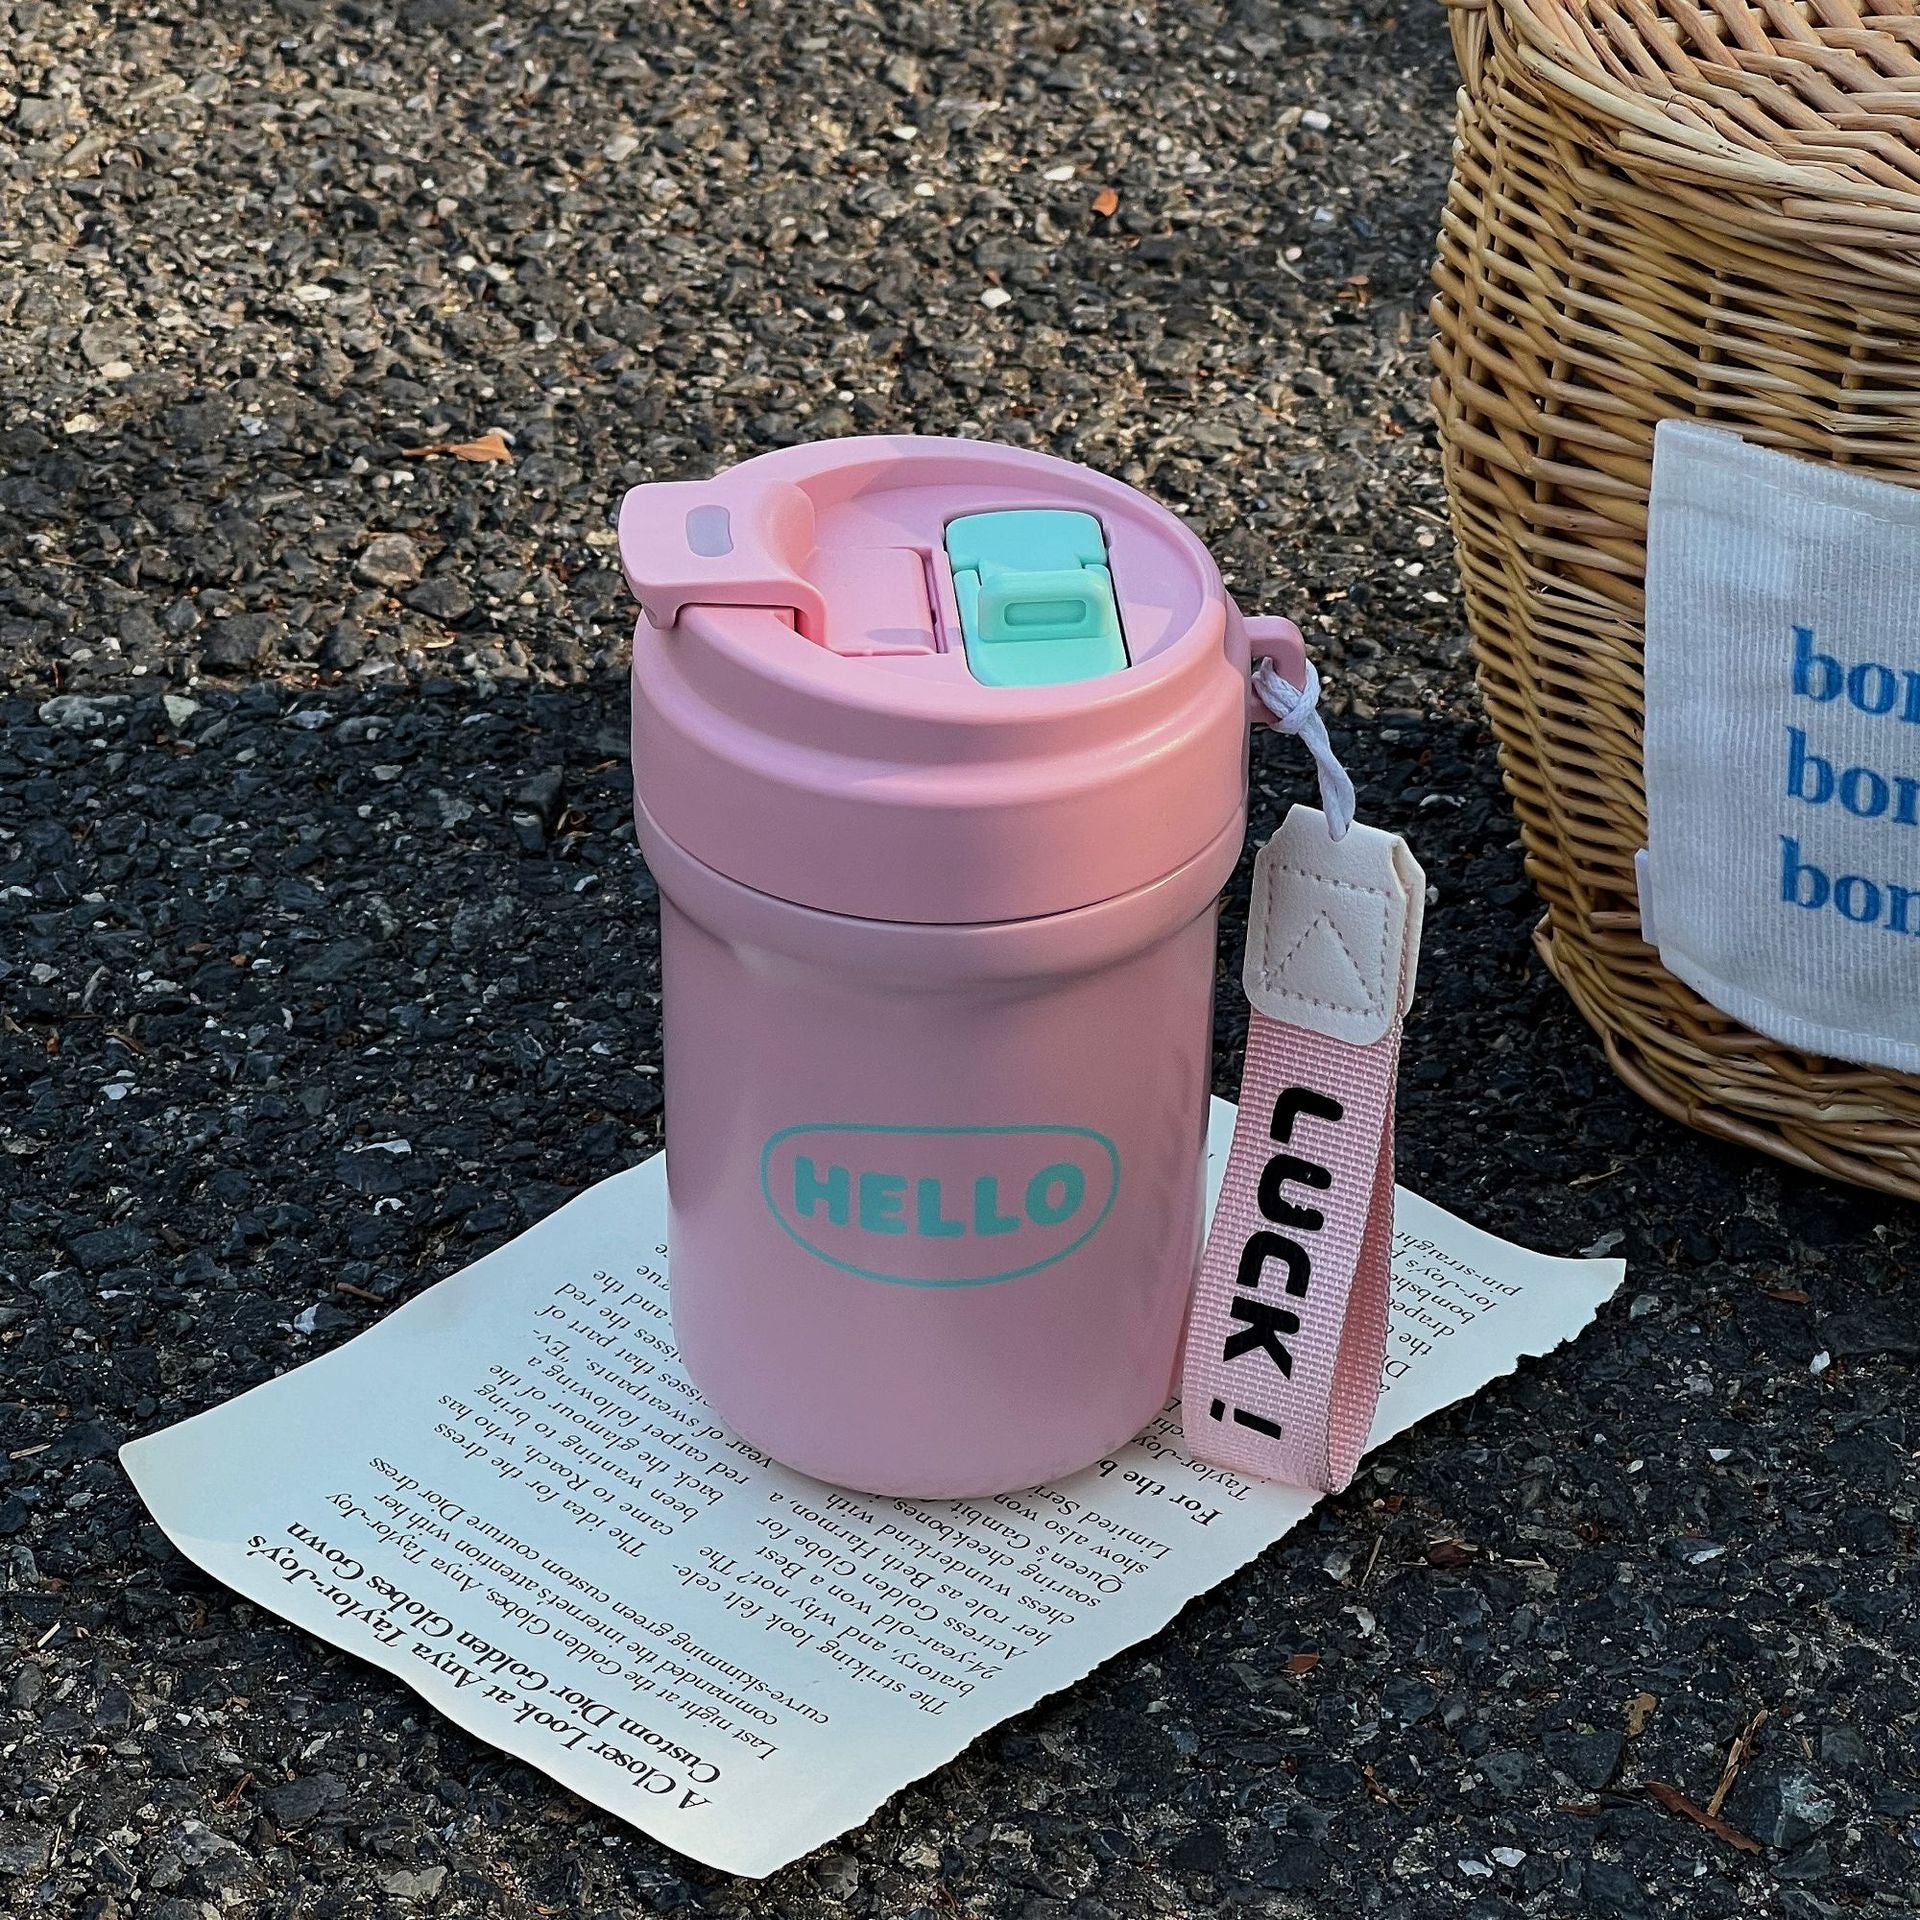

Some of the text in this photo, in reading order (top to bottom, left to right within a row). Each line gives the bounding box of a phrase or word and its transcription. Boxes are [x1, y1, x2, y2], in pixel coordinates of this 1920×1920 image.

[793, 1156, 1086, 1239] HELLO
[534, 1304, 567, 1320] of
[593, 1270, 669, 1319] and the
[1395, 1232, 1523, 1297] pin-straight
[1405, 1259, 1498, 1313] lor-Joy's
[553, 1282, 683, 1364] isses the red
[567, 1320, 619, 1348] part
[613, 1348, 656, 1375] that
[1398, 1332, 1433, 1357] the
[489, 1364, 724, 1506] back the glamour of the
[527, 1356, 750, 1485] red carpet following a
[586, 1358, 700, 1427] sweatpants.
[690, 1425, 724, 1440] of
[433, 1423, 648, 1558] The idea for the dress
[438, 1394, 674, 1536] came to Roach, who has
[473, 1383, 699, 1524] been wanting to bring
[1122, 1470, 1223, 1527] For the
[769, 1491, 1053, 1647] her role as Beth Harmon, a
[825, 1493, 1075, 1625] chess wunderkind with
[993, 1493, 1149, 1575] show also won
[1021, 1484, 1173, 1560] Limited Seri
[1035, 1544, 1127, 1594] Queen's
[324, 1493, 780, 1761] Last night at the Golden Globes, Anya Taylor-Joy
[369, 1457, 829, 1724] curve-skimming green custom couture Dior dress
[373, 1494, 778, 1725] commanded the internet's attention with her
[699, 1546, 976, 1698] bratory, and why not? The
[754, 1545, 1004, 1680] 24-year-old won a Best
[756, 1517, 1028, 1661] Actress Golden Globe for
[1016, 1563, 1101, 1607] soaring
[245, 1535, 713, 1810] A Closer Look at Anya Taylor-Joy's
[286, 1521, 721, 1784] Custom Dior Golden Globes Gown
[671, 1564, 950, 1715] The striking look felt cele-
